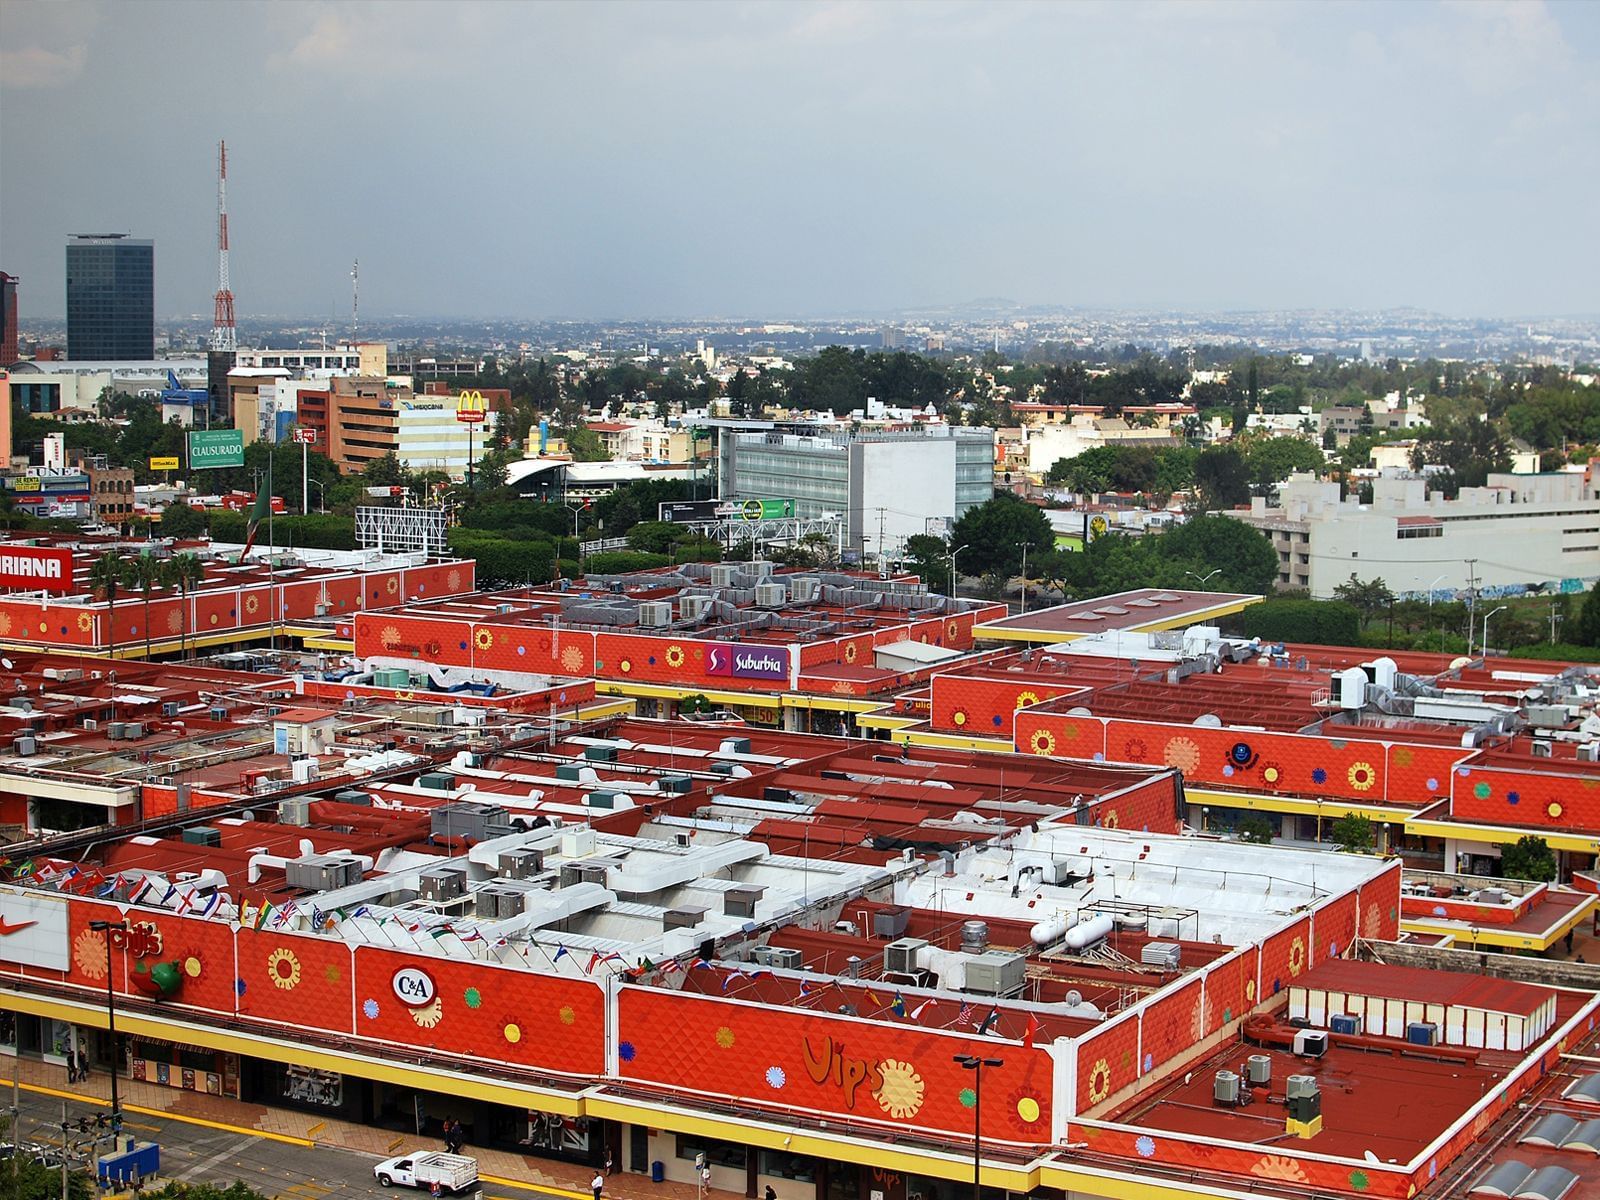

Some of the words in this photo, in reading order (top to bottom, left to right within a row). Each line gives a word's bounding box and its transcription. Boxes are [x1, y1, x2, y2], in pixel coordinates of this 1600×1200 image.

[192, 444, 242, 457] CLAUSURADO
[0, 555, 61, 578] RIANA
[735, 653, 781, 672] Suburbia
[398, 976, 428, 998] C&A
[802, 1036, 885, 1110] Vips
[873, 1167, 901, 1190] Vips
